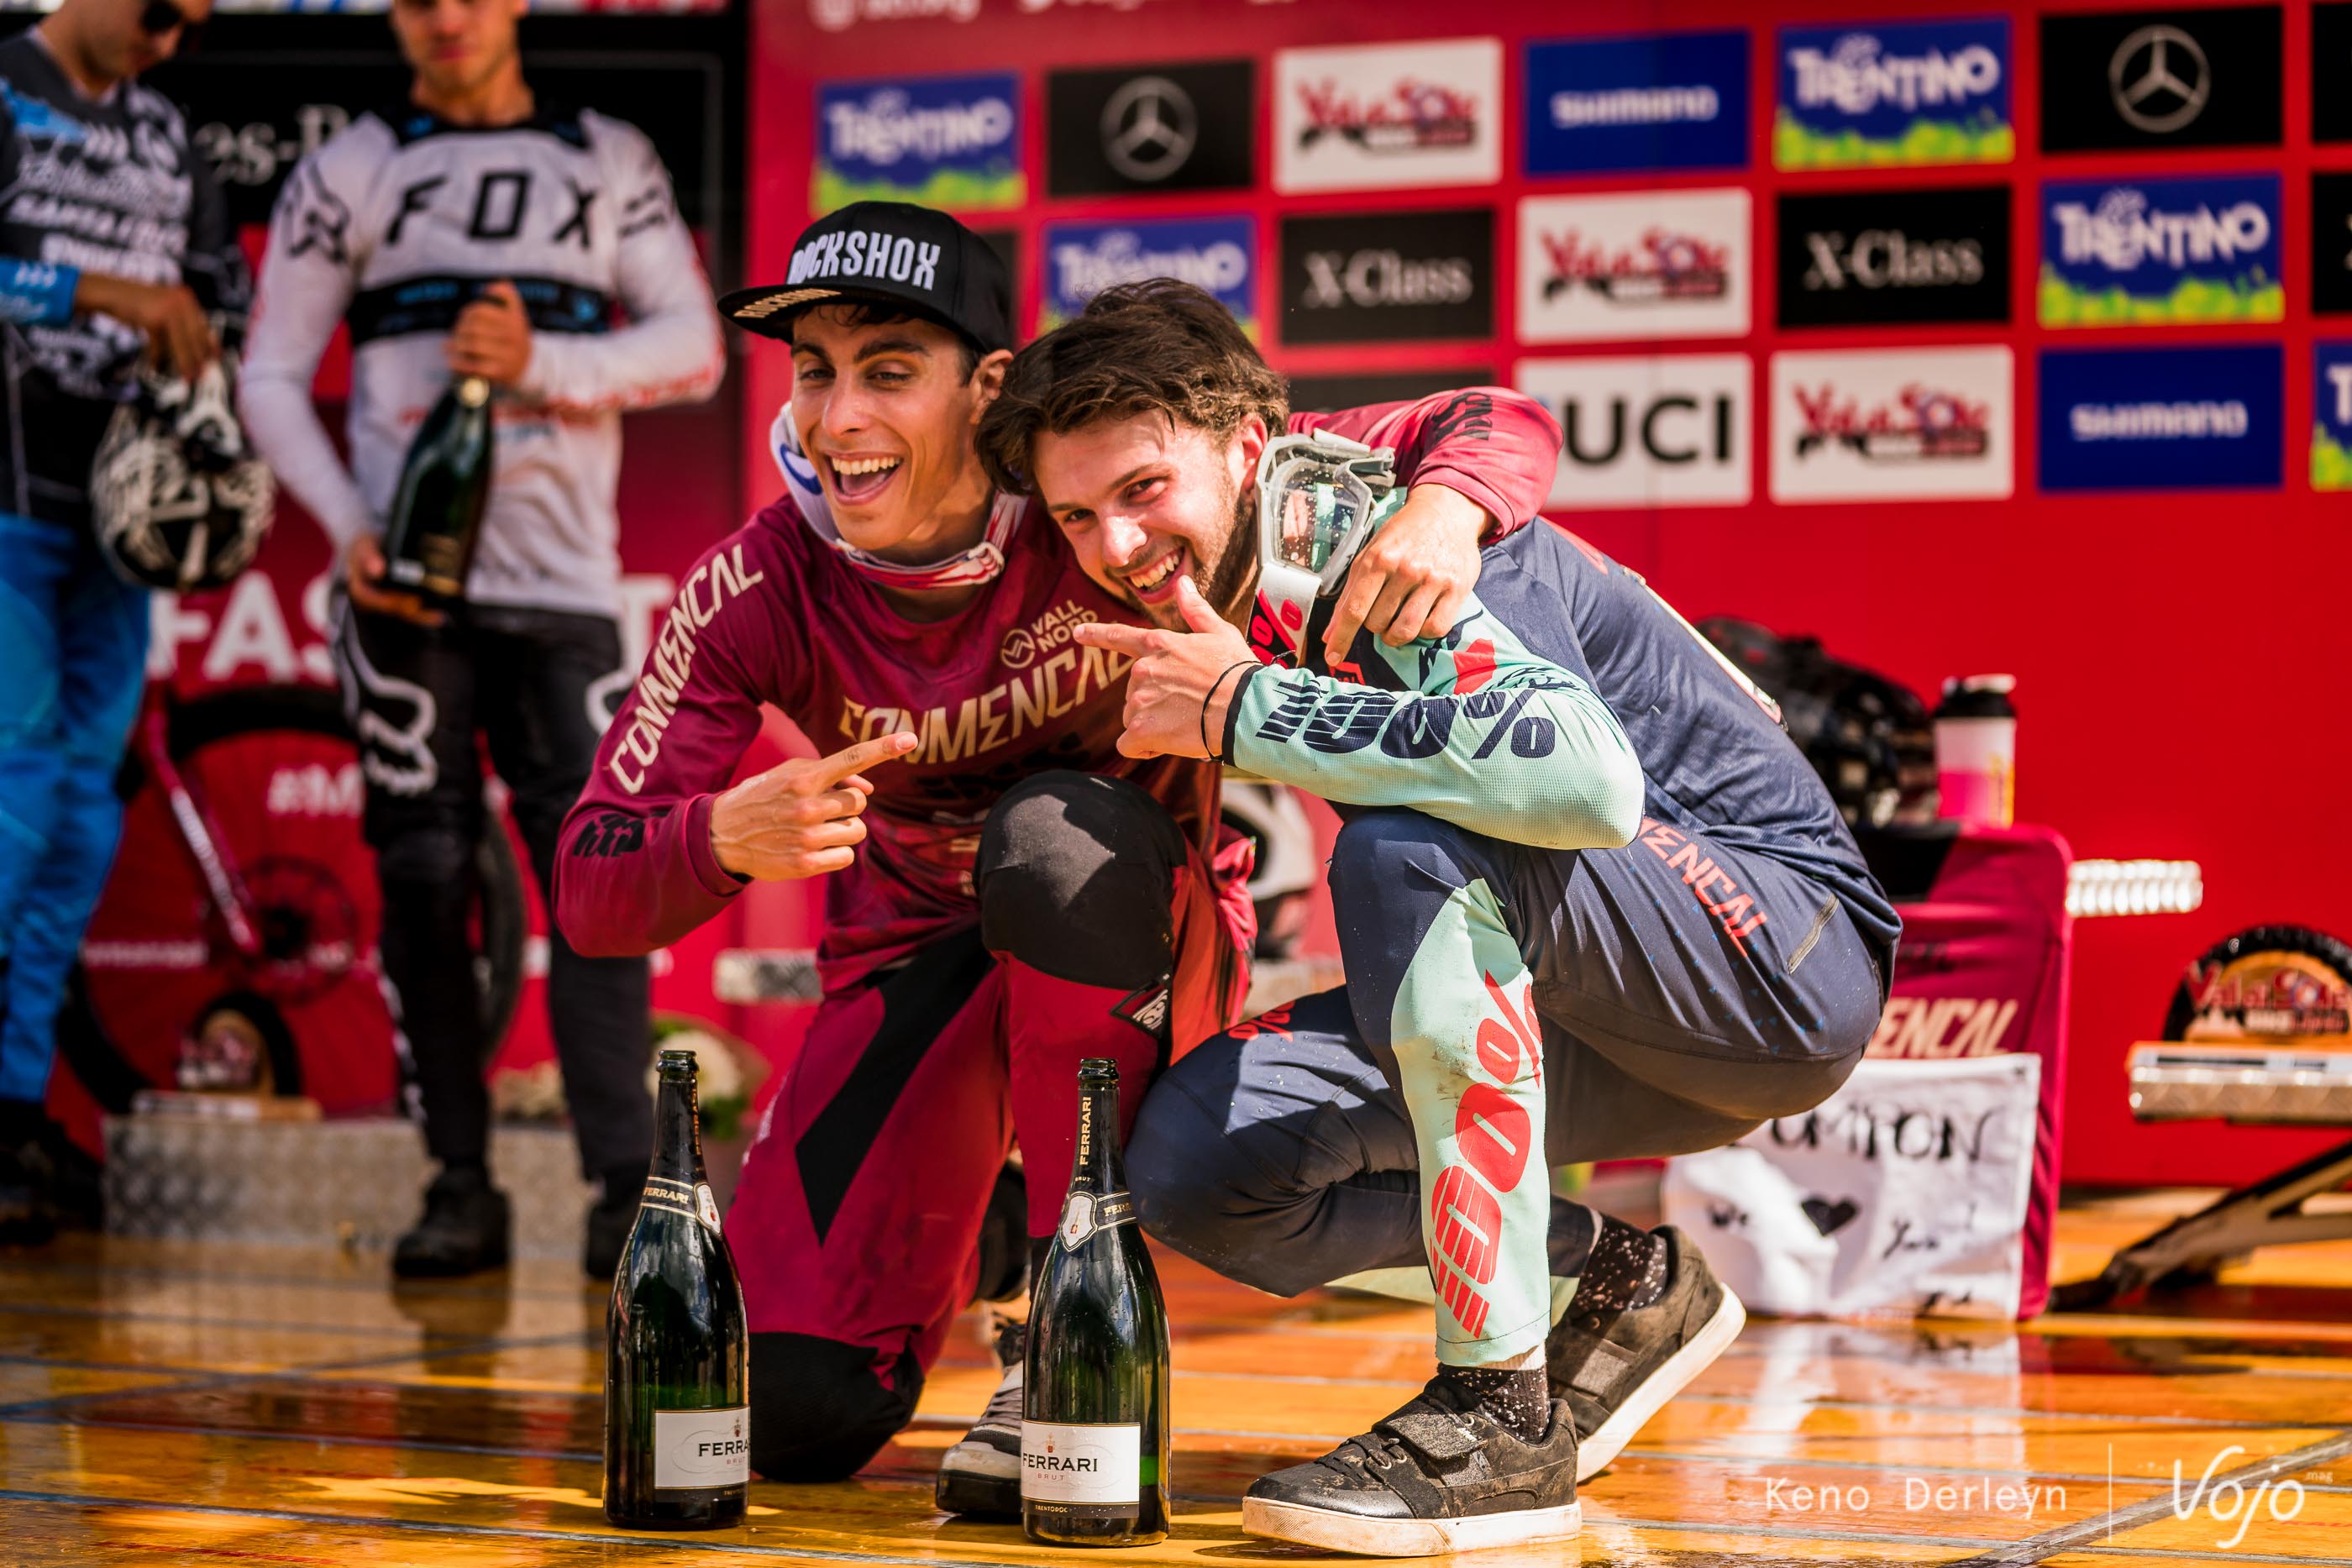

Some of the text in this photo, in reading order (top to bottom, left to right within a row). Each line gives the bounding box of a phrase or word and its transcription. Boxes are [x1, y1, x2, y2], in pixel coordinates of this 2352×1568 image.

[1788, 40, 2000, 113] TRENTINO
[385, 170, 597, 249] FOX
[2051, 191, 2270, 270] TRENTINO
[786, 230, 941, 291] ROCKSHOX
[1303, 251, 1473, 308] X-Class
[1805, 229, 1983, 289] X-Class
[1565, 394, 1730, 464] UCI
[1031, 600, 1084, 635] VALL
[1037, 610, 1098, 653] NORD
[609, 543, 764, 794] COMMENCAL
[1255, 679, 1556, 760] 100%
[1079, 1097, 1091, 1166] FERRARI
[1430, 968, 1543, 1340] 100%
[643, 1188, 690, 1205] FERRARI
[1022, 1453, 1099, 1472] FERRARI
